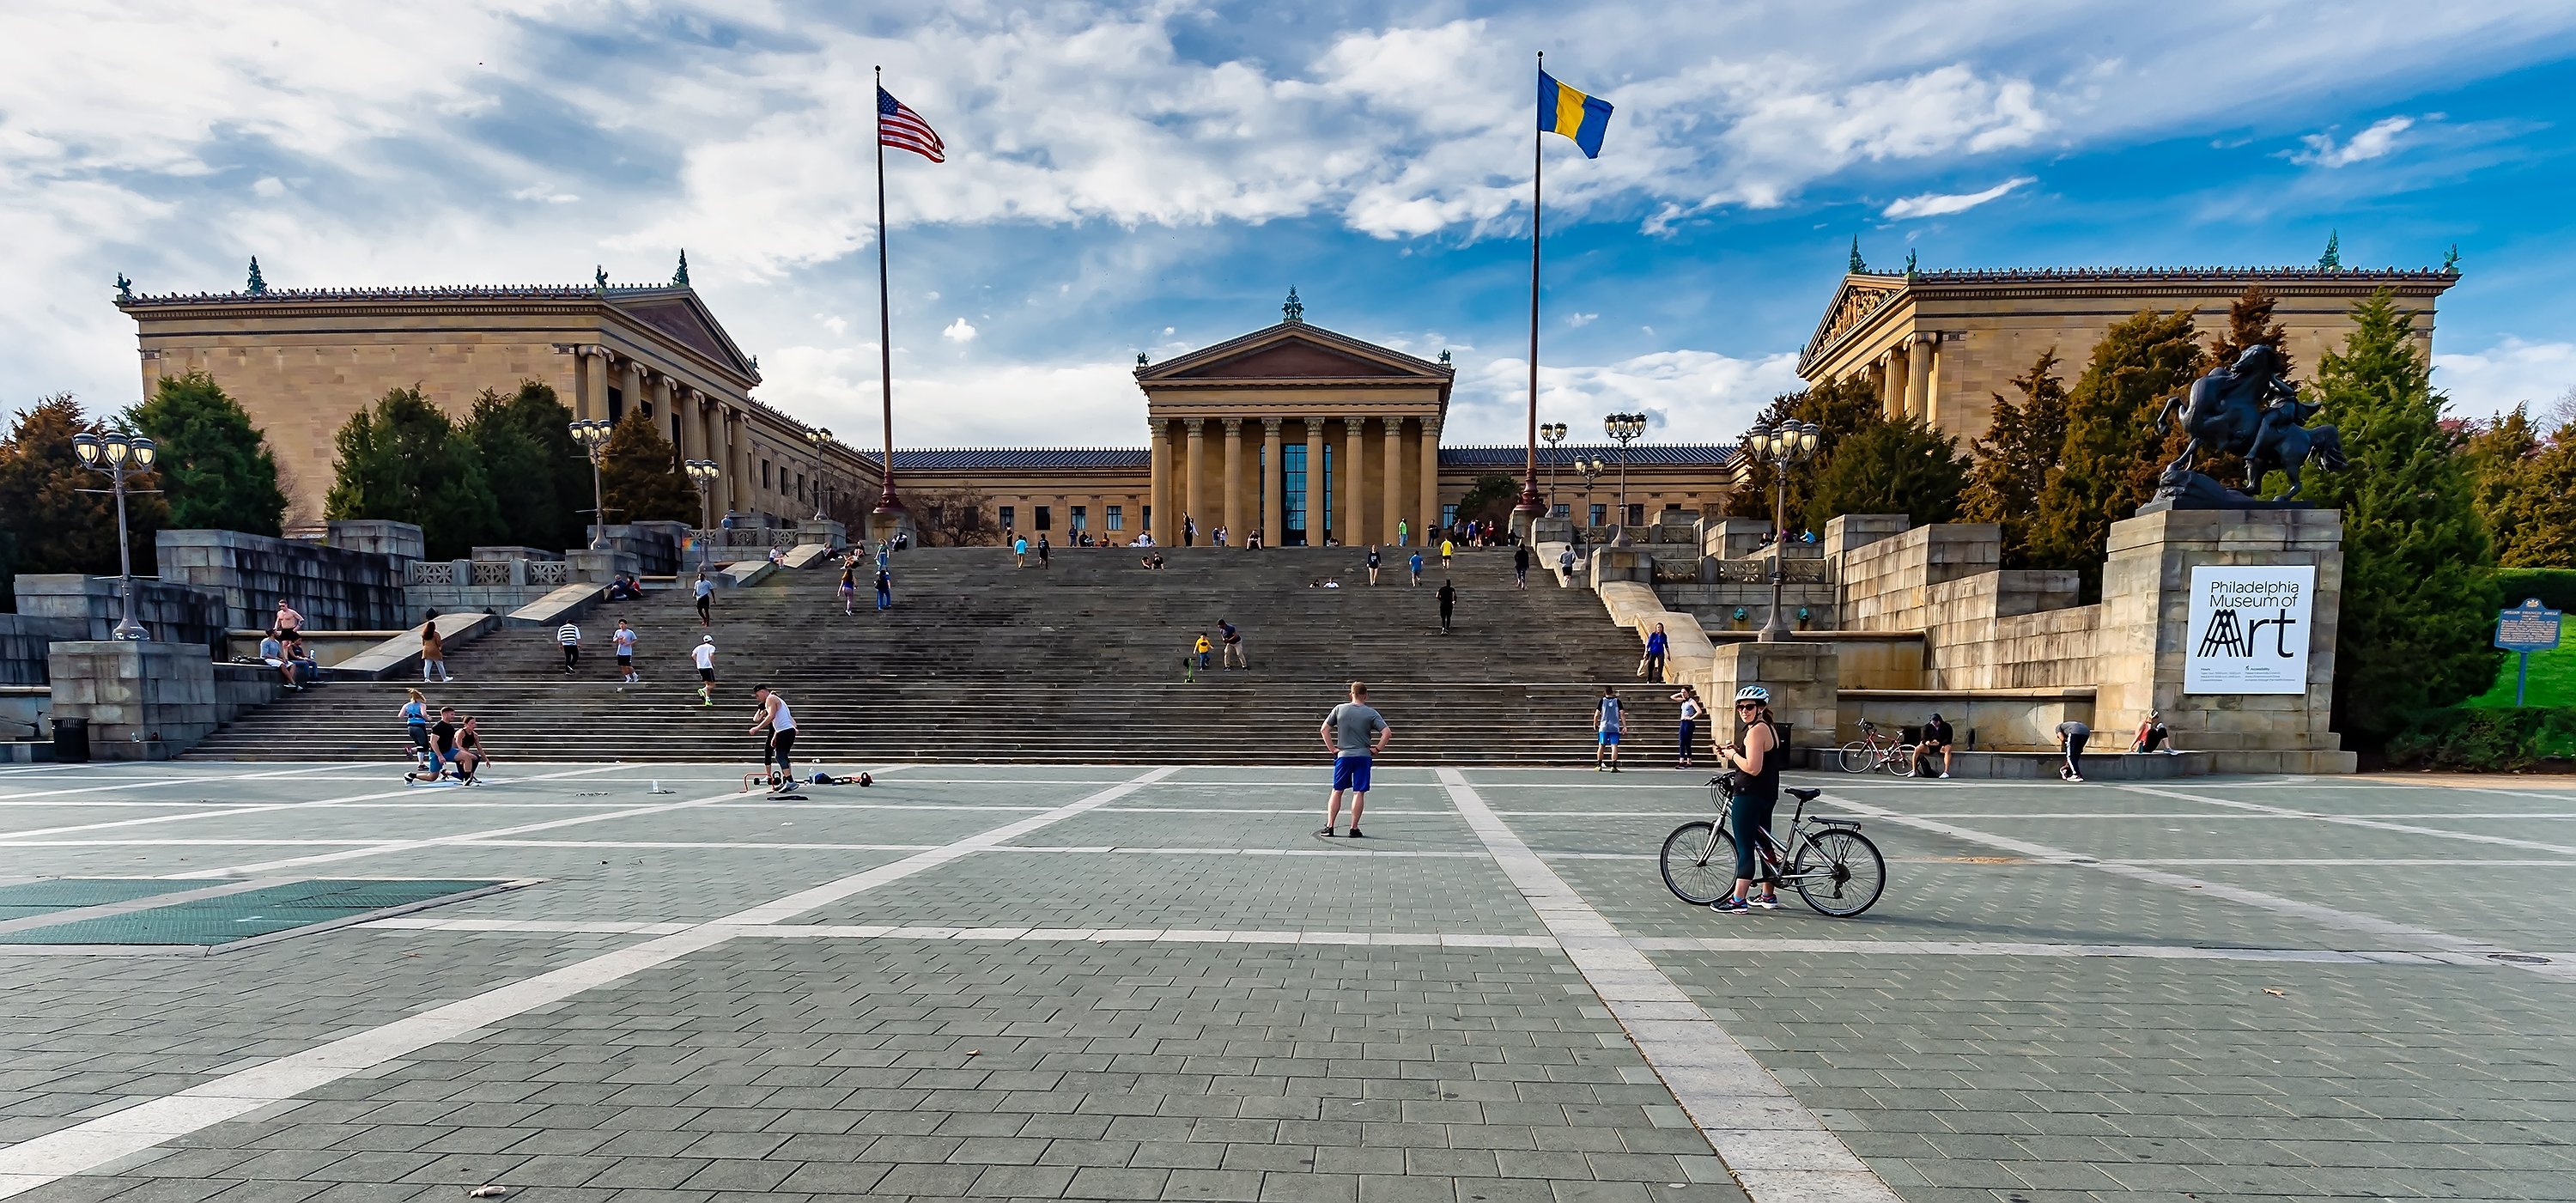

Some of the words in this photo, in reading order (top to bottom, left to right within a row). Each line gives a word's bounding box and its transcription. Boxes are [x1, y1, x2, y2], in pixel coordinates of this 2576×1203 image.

[2210, 580, 2300, 596] Philadelphia
[2209, 594, 2279, 608] Museum
[2281, 592, 2299, 608] of
[2196, 608, 2296, 658] Art
